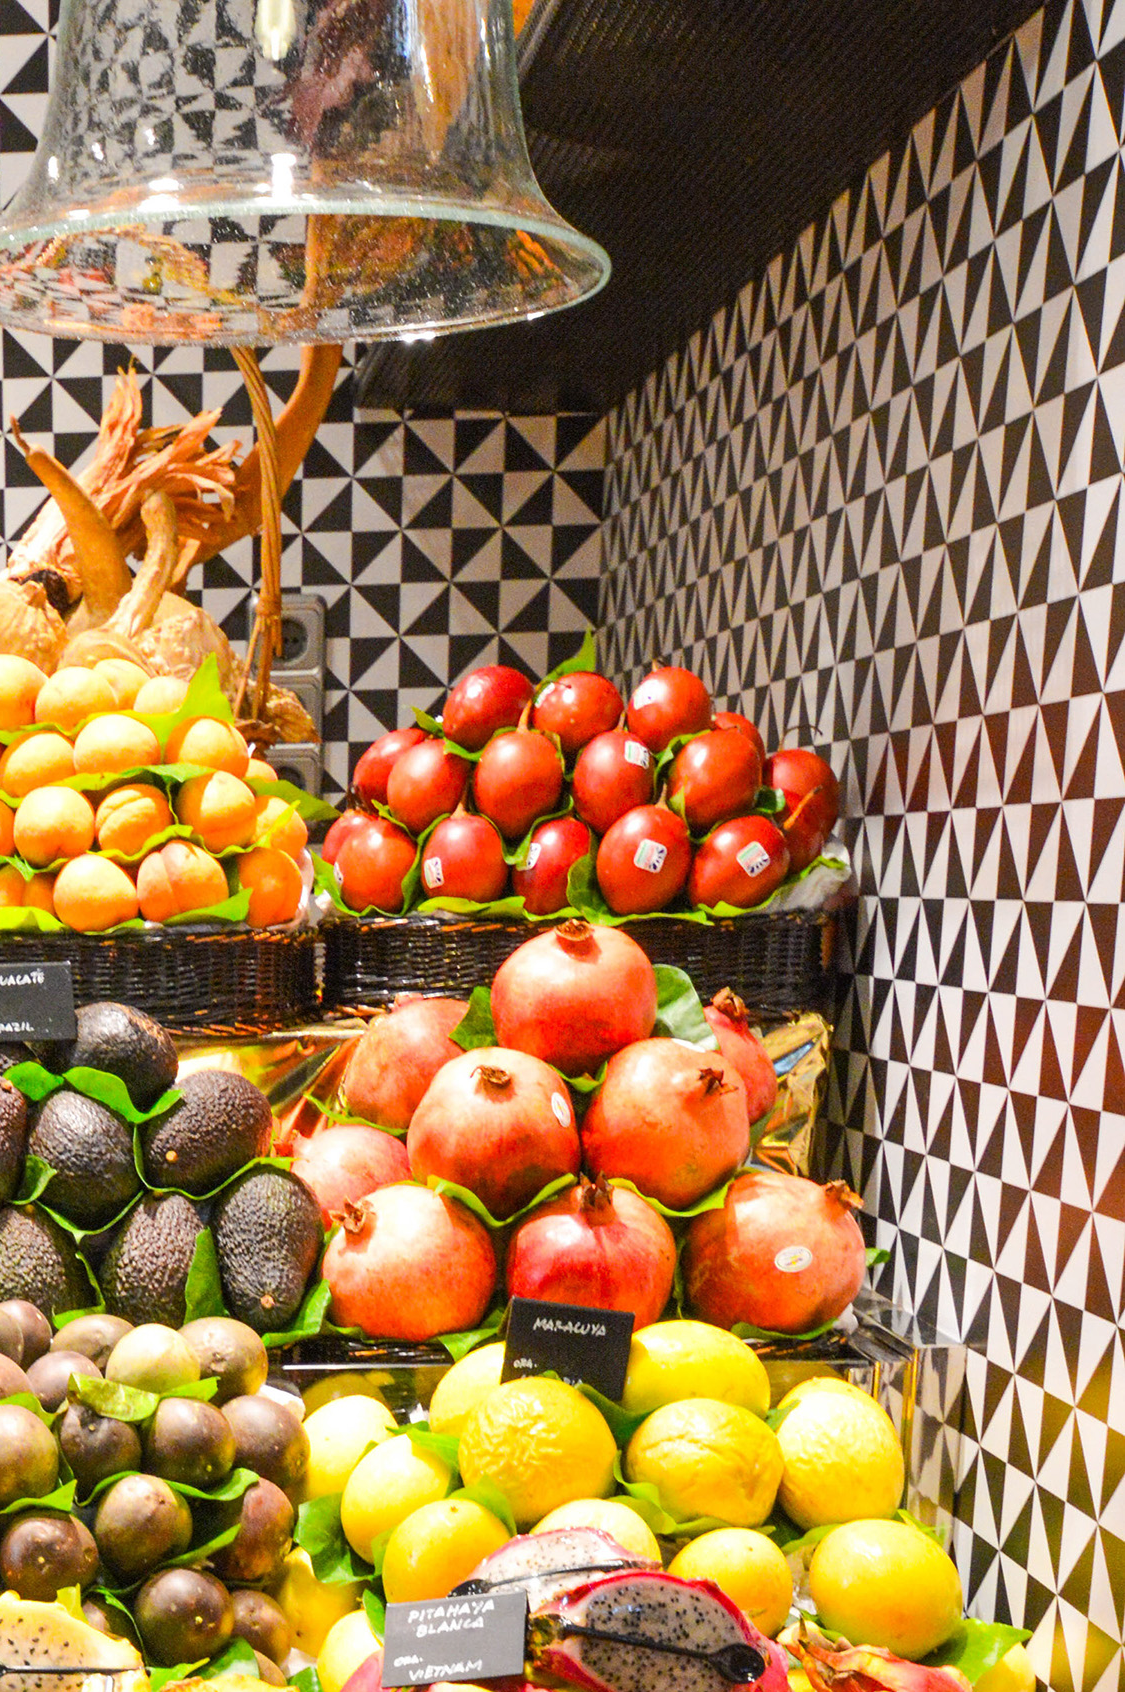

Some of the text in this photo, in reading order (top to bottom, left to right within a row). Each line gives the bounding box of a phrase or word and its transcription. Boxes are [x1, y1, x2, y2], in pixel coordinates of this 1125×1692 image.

[532, 1317, 607, 1337] MARACUYA
[407, 1599, 495, 1624] PITAHAYA
[416, 1616, 484, 1638] BLANCA
[408, 1659, 483, 1681] VIETNAM
